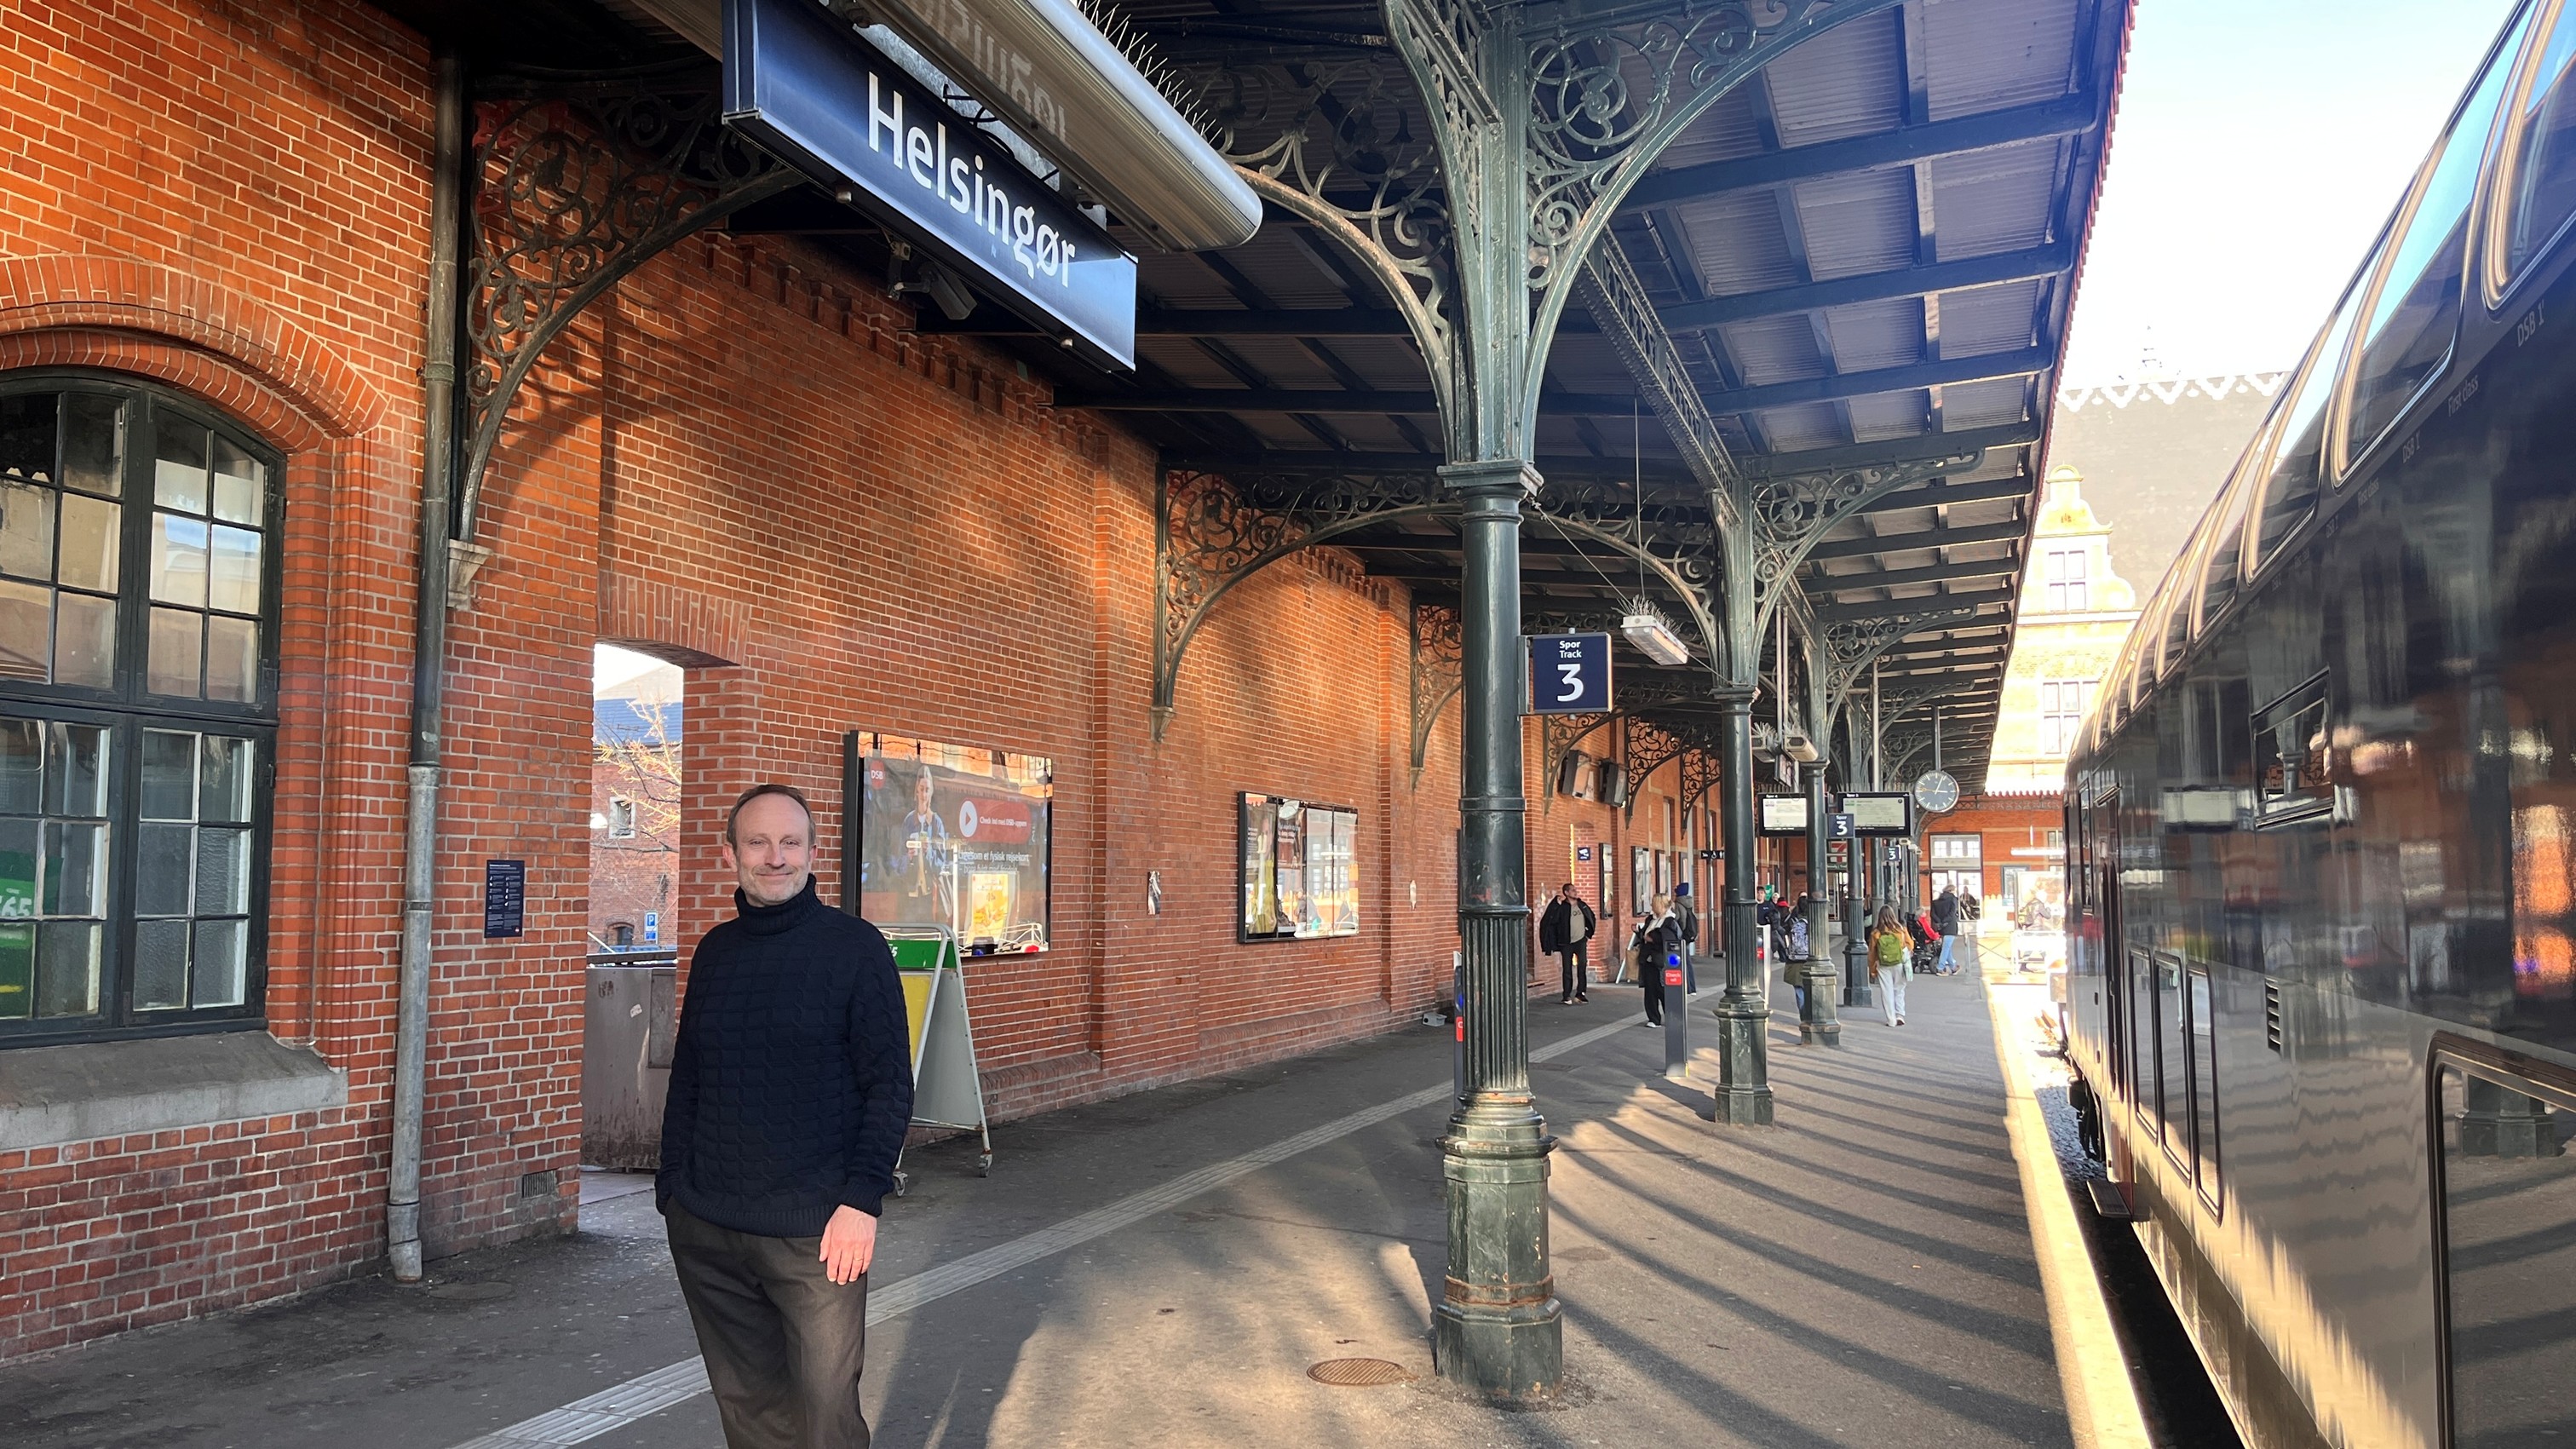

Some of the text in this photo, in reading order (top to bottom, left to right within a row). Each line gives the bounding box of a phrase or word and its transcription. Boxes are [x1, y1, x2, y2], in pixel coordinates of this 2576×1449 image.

[868, 71, 1075, 288] Helsingør
[2517, 311, 2536, 348] DSB
[2448, 375, 2479, 417] First class
[1559, 641, 1581, 650] Spor
[1559, 650, 1582, 658] Track
[1557, 664, 1584, 702] 3
[871, 770, 883, 779] DSB
[1836, 820, 1848, 836] 3
[984, 852, 989, 860] et
[990, 850, 1005, 863] fysisk
[1006, 852, 1029, 863] rejsekort
[1889, 851, 1896, 860] 3
[649, 915, 655, 926] P
